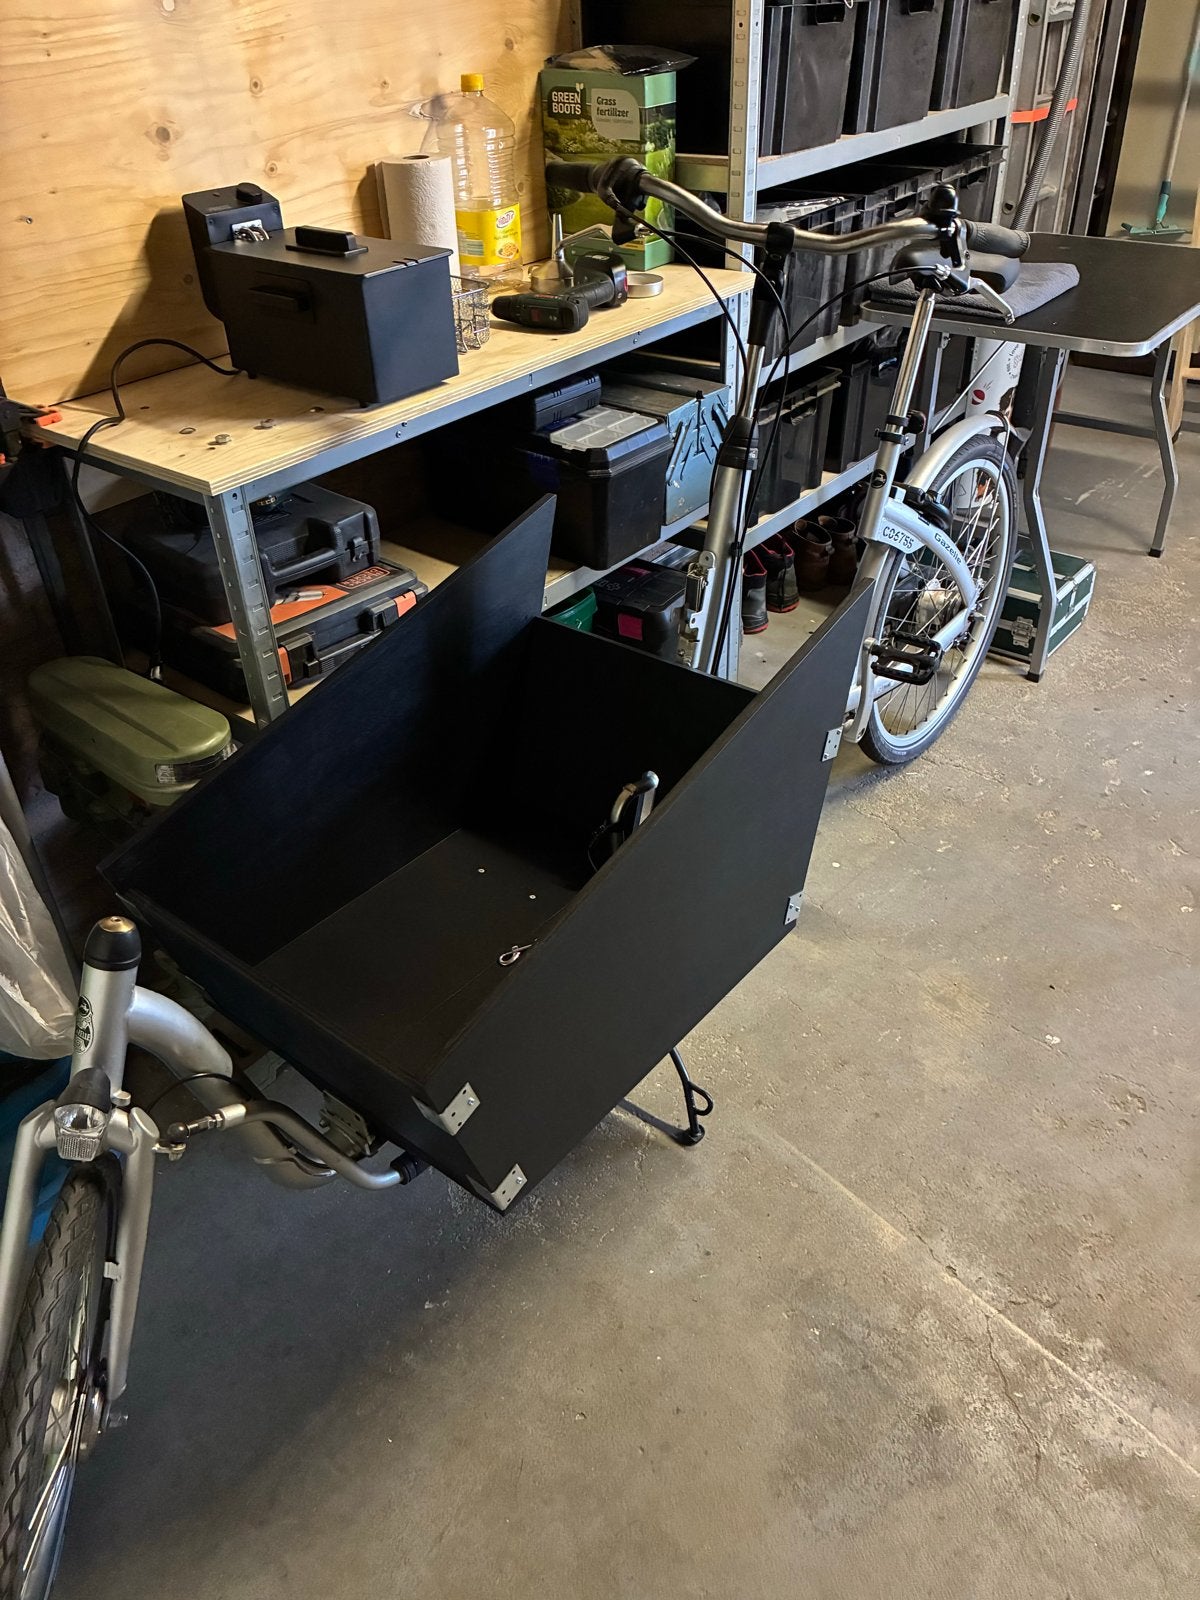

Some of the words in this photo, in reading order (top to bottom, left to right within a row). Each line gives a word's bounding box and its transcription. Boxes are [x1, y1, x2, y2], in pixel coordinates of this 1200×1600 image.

[552, 91, 581, 104] GREEN
[596, 96, 617, 106] Grass
[552, 102, 582, 115] BOOTS
[596, 106, 629, 117] fertilizer
[934, 532, 962, 565] Gazelle
